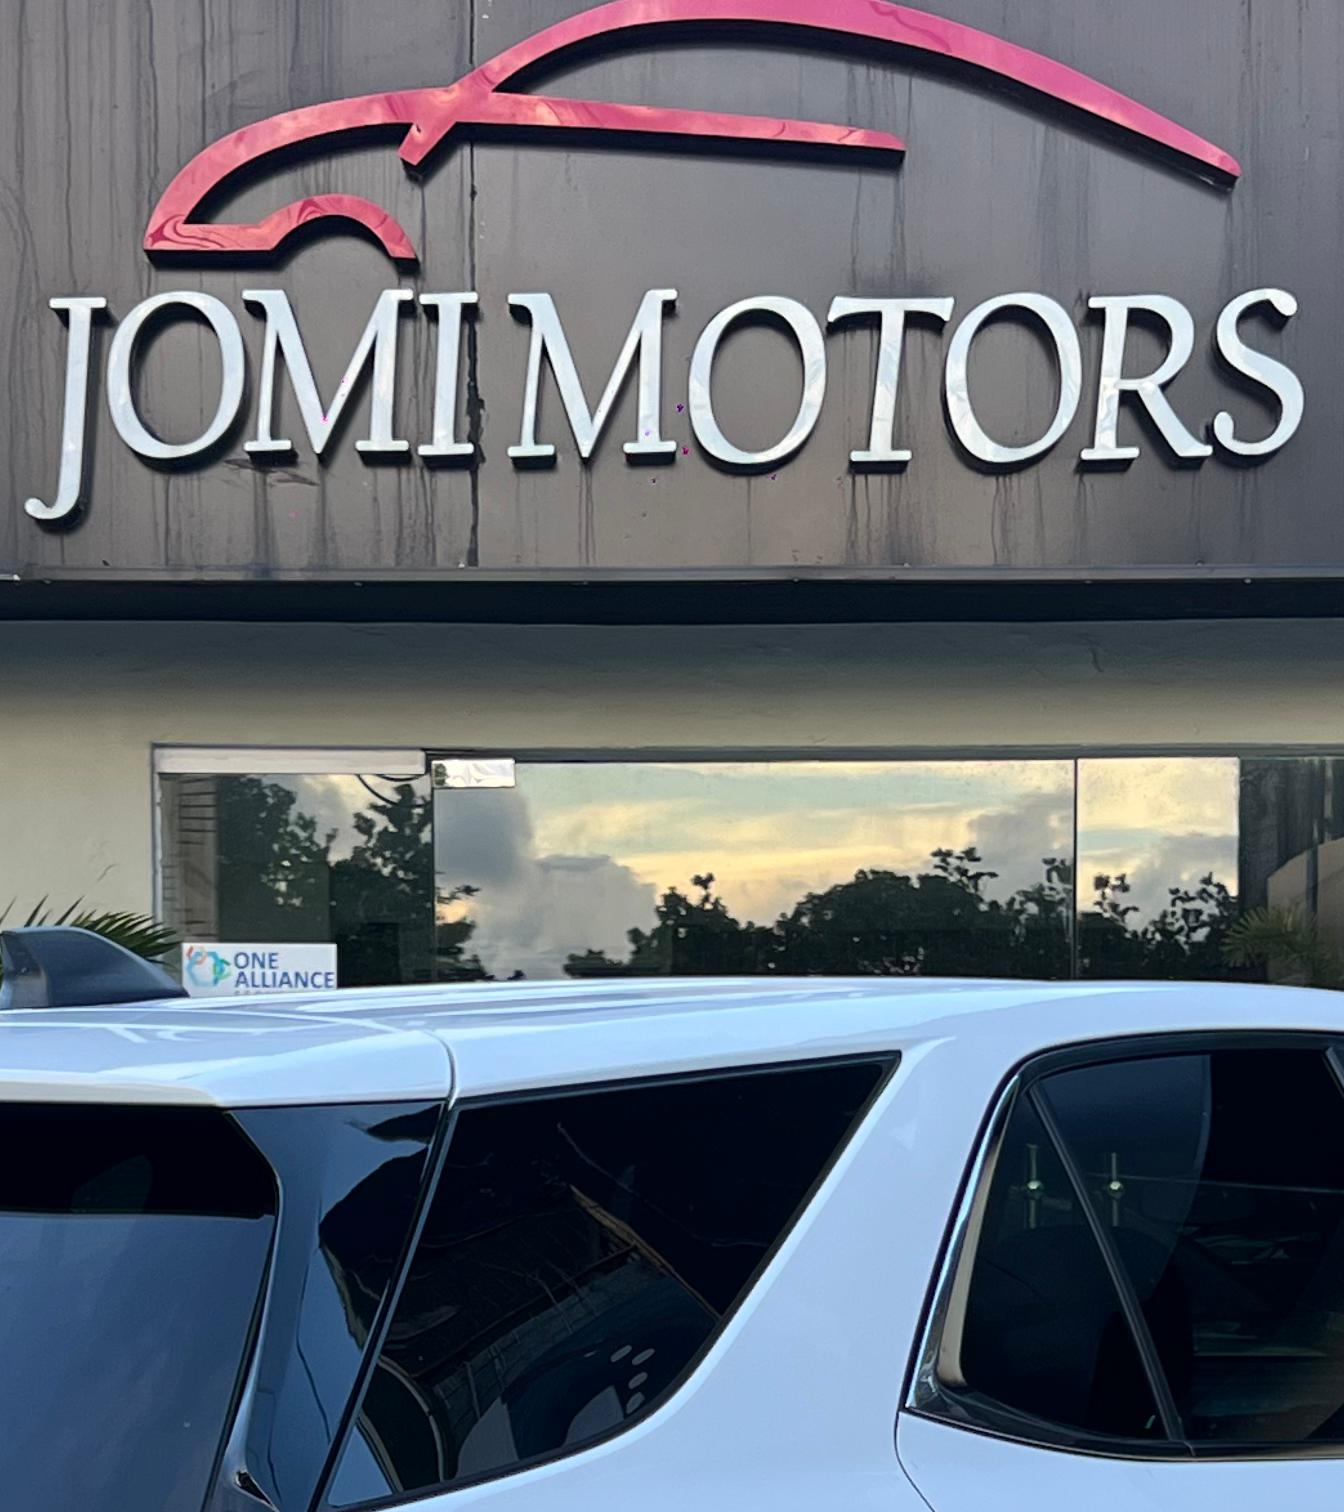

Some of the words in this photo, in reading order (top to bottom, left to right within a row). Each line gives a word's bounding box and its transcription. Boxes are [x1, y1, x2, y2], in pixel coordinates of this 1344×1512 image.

[25, 287, 478, 520] JOMI
[507, 287, 1305, 465] MOTORS
[233, 951, 279, 970] ONE
[233, 970, 335, 989] ALLIANCE
